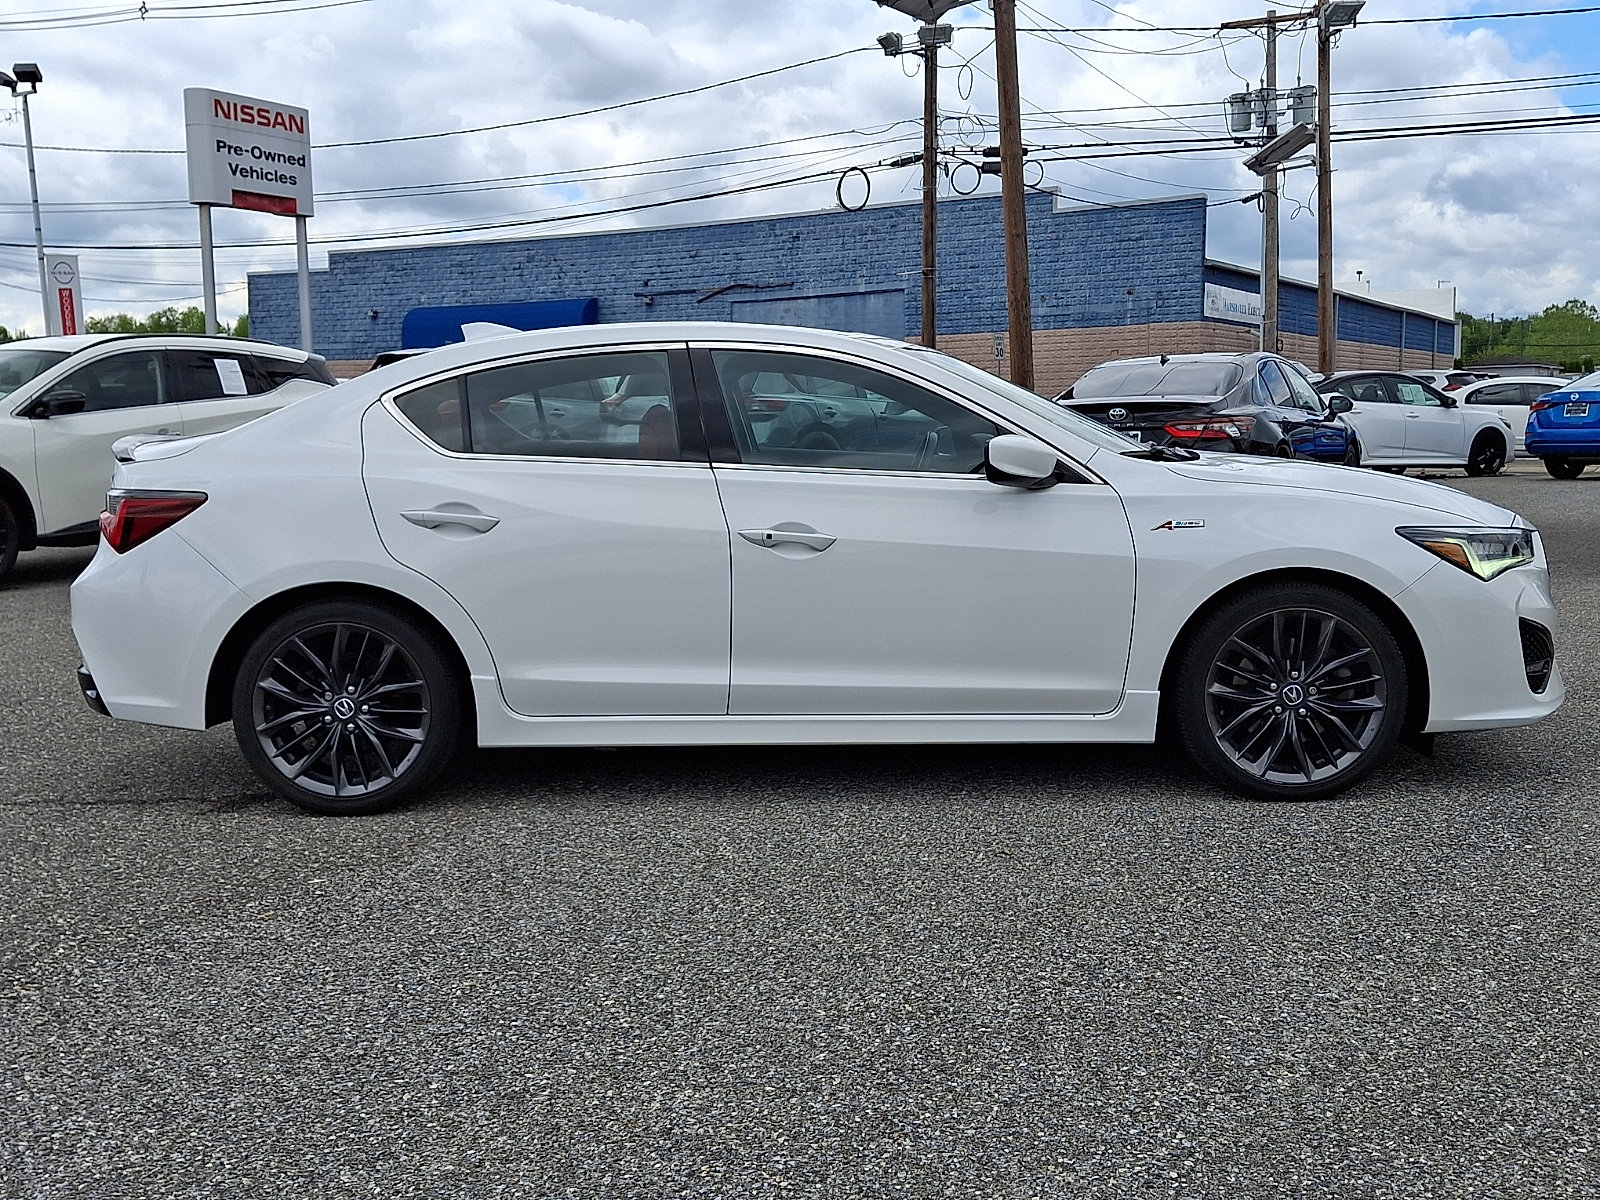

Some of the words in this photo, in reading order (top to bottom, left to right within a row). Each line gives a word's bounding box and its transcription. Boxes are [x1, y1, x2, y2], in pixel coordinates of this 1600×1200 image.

[213, 98, 305, 134] NISSAN
[215, 139, 306, 168] Pre-Owned
[228, 162, 298, 186] Vehicles
[995, 347, 1004, 358] 30
